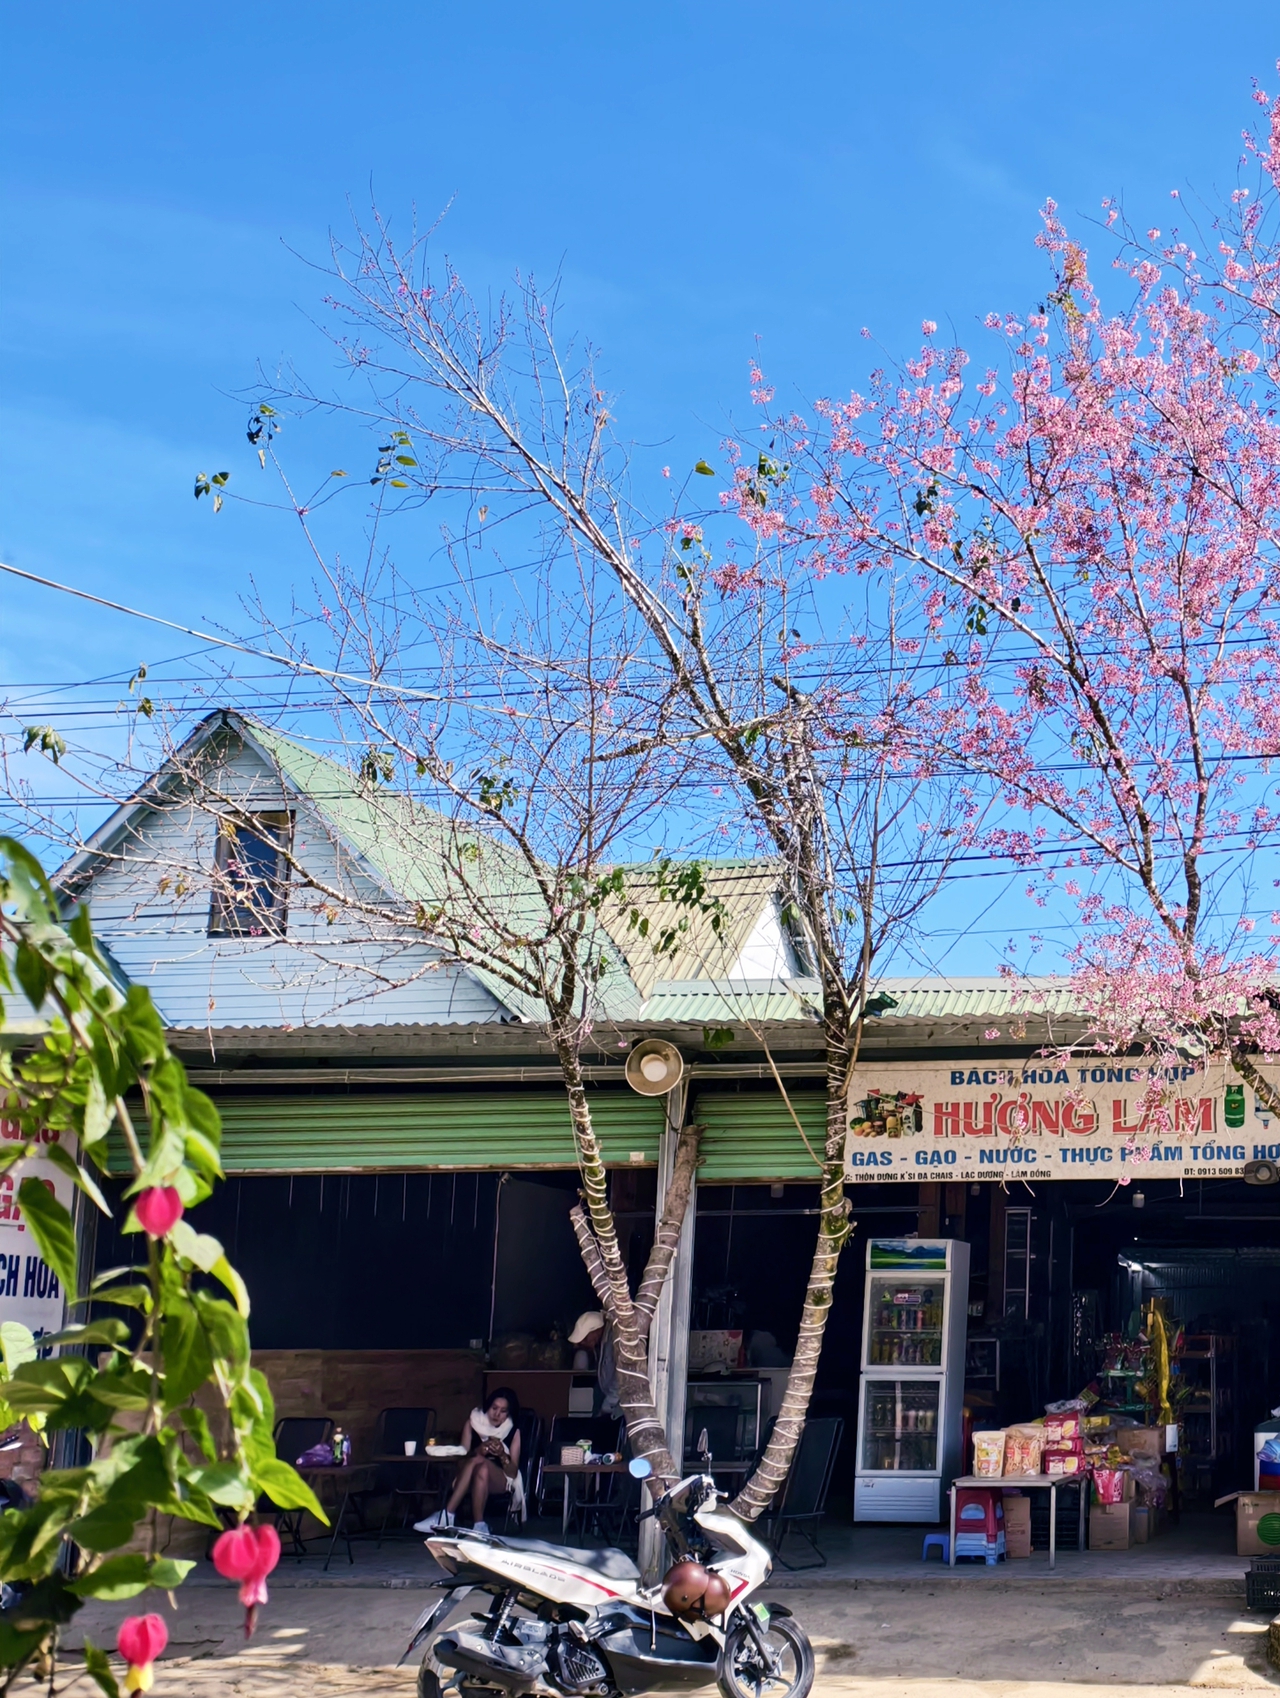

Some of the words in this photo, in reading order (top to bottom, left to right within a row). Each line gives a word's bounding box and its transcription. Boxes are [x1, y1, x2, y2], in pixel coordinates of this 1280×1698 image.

[851, 1151, 893, 1166] GAS
[915, 1150, 957, 1168] GẠO
[979, 1146, 1037, 1164] NƯỚC
[1059, 1147, 1113, 1165] THỰC
[1120, 1141, 1182, 1161] PẨM
[1190, 1140, 1246, 1161] TỔNG
[930, 1172, 954, 1180] CHAIS
[1197, 1167, 1217, 1176] 0913
